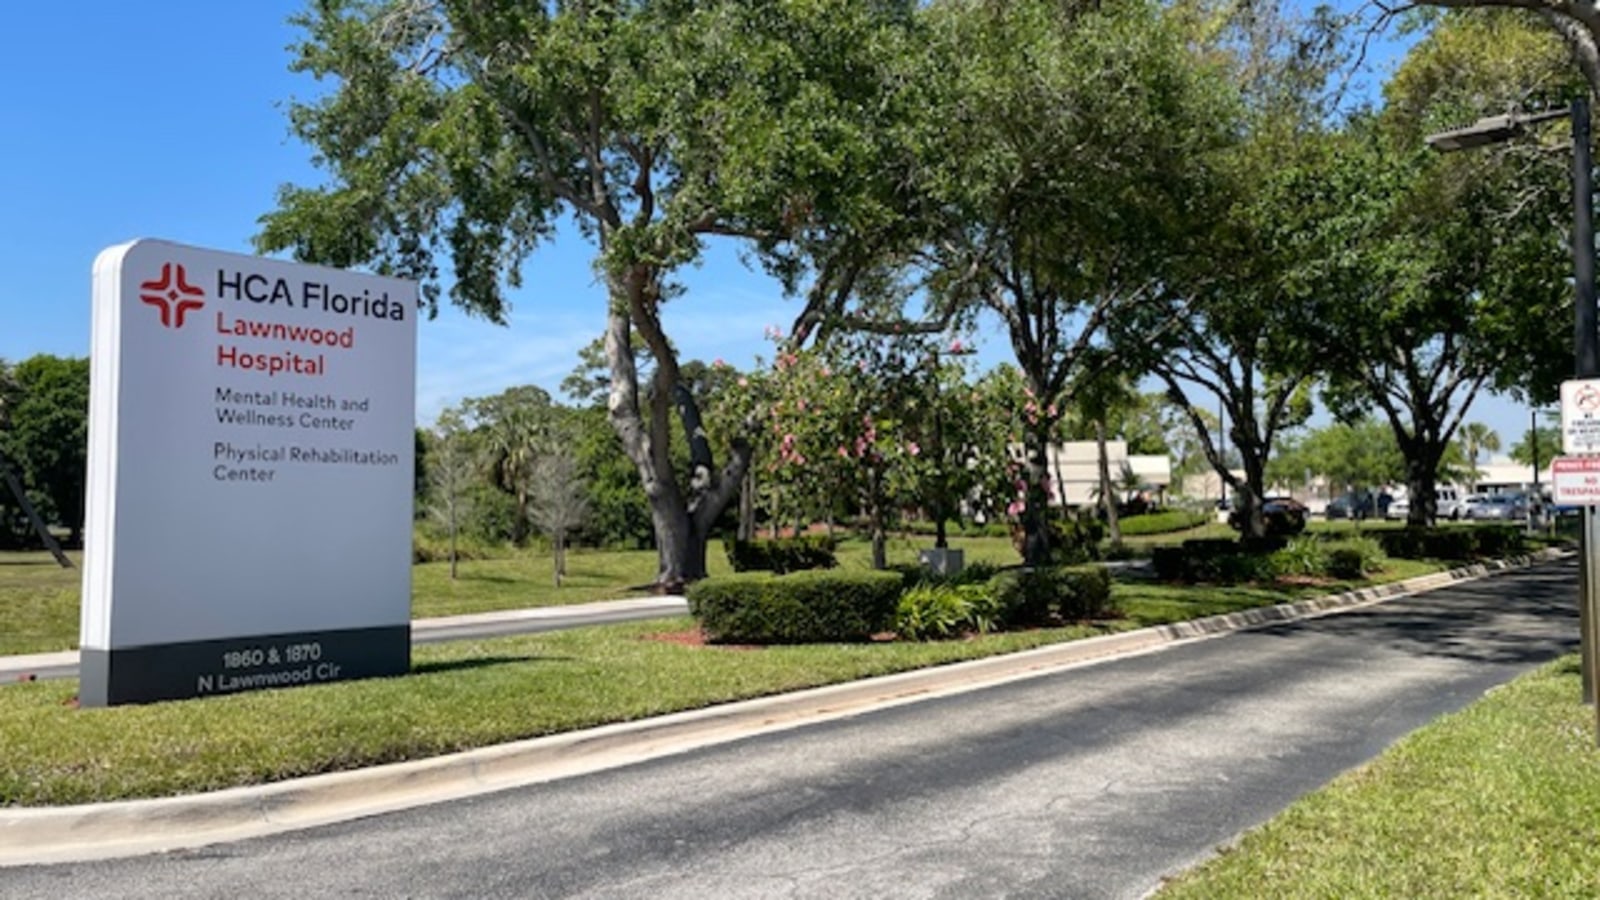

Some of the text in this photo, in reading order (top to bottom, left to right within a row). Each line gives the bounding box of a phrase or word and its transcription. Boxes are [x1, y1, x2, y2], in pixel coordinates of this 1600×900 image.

[217, 269, 404, 321] HCA Florida
[217, 312, 354, 349] Lawnwood
[217, 345, 324, 377] Hospital
[215, 386, 370, 413] Mental Health and
[215, 408, 355, 431] Wellness Center
[213, 441, 399, 466] Physical Rehabilitation
[212, 464, 276, 482] Center
[223, 643, 322, 668] 1860 & 1870
[198, 662, 341, 692] N Lawnwood Cir
